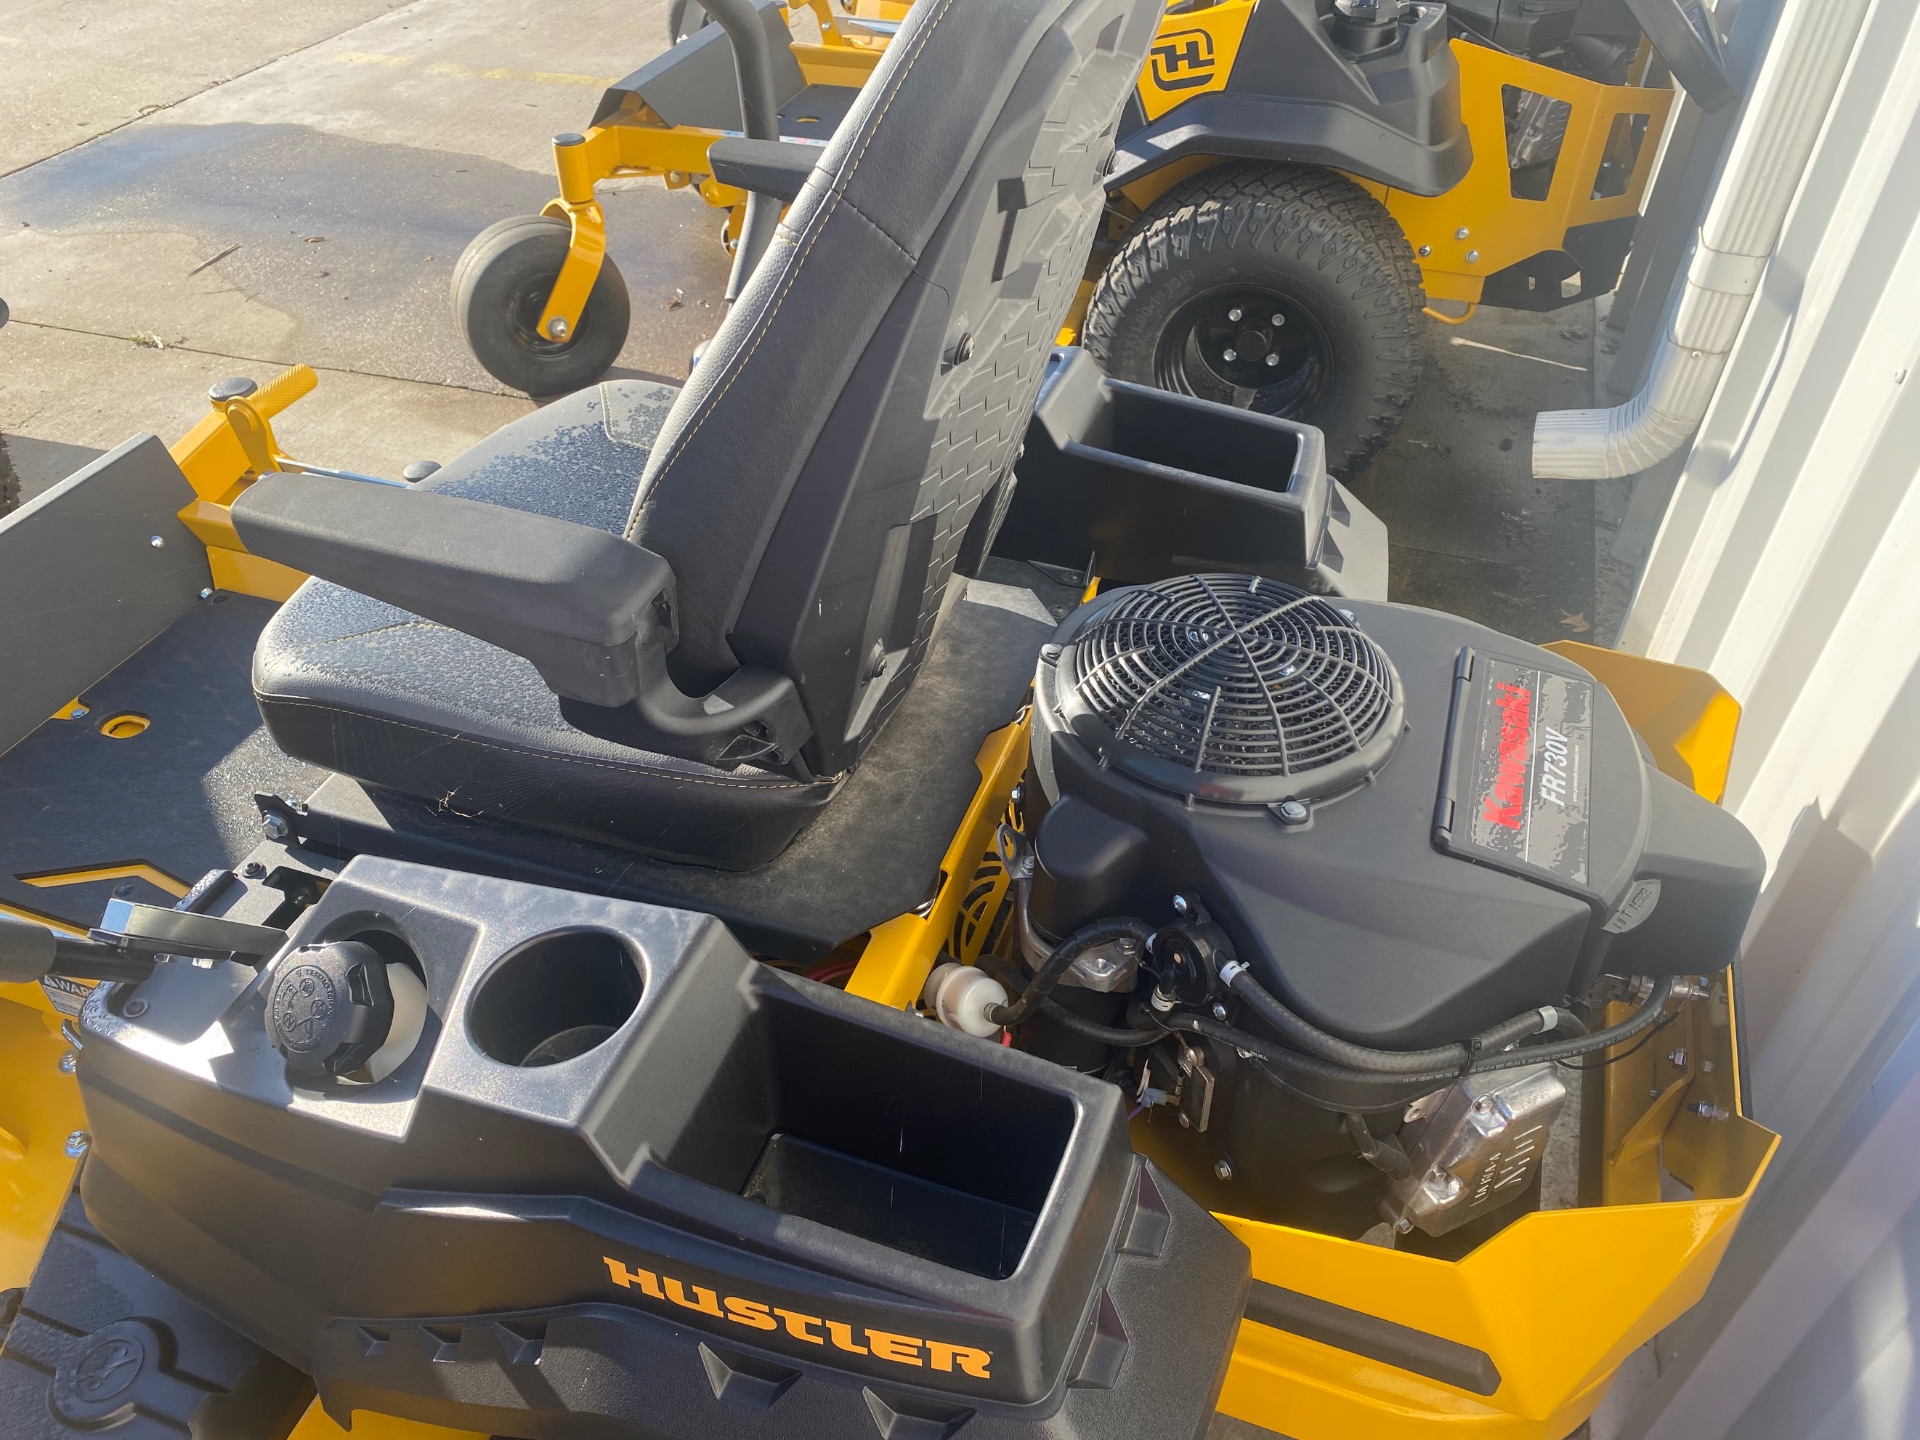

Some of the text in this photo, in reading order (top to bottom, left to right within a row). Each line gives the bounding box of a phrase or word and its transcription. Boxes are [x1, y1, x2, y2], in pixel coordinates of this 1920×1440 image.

[1483, 682, 1531, 830] Kawasaki
[1541, 726, 1568, 807] FR730V
[1629, 887, 1652, 910] HERE
[603, 1256, 992, 1379] HUSTLER
